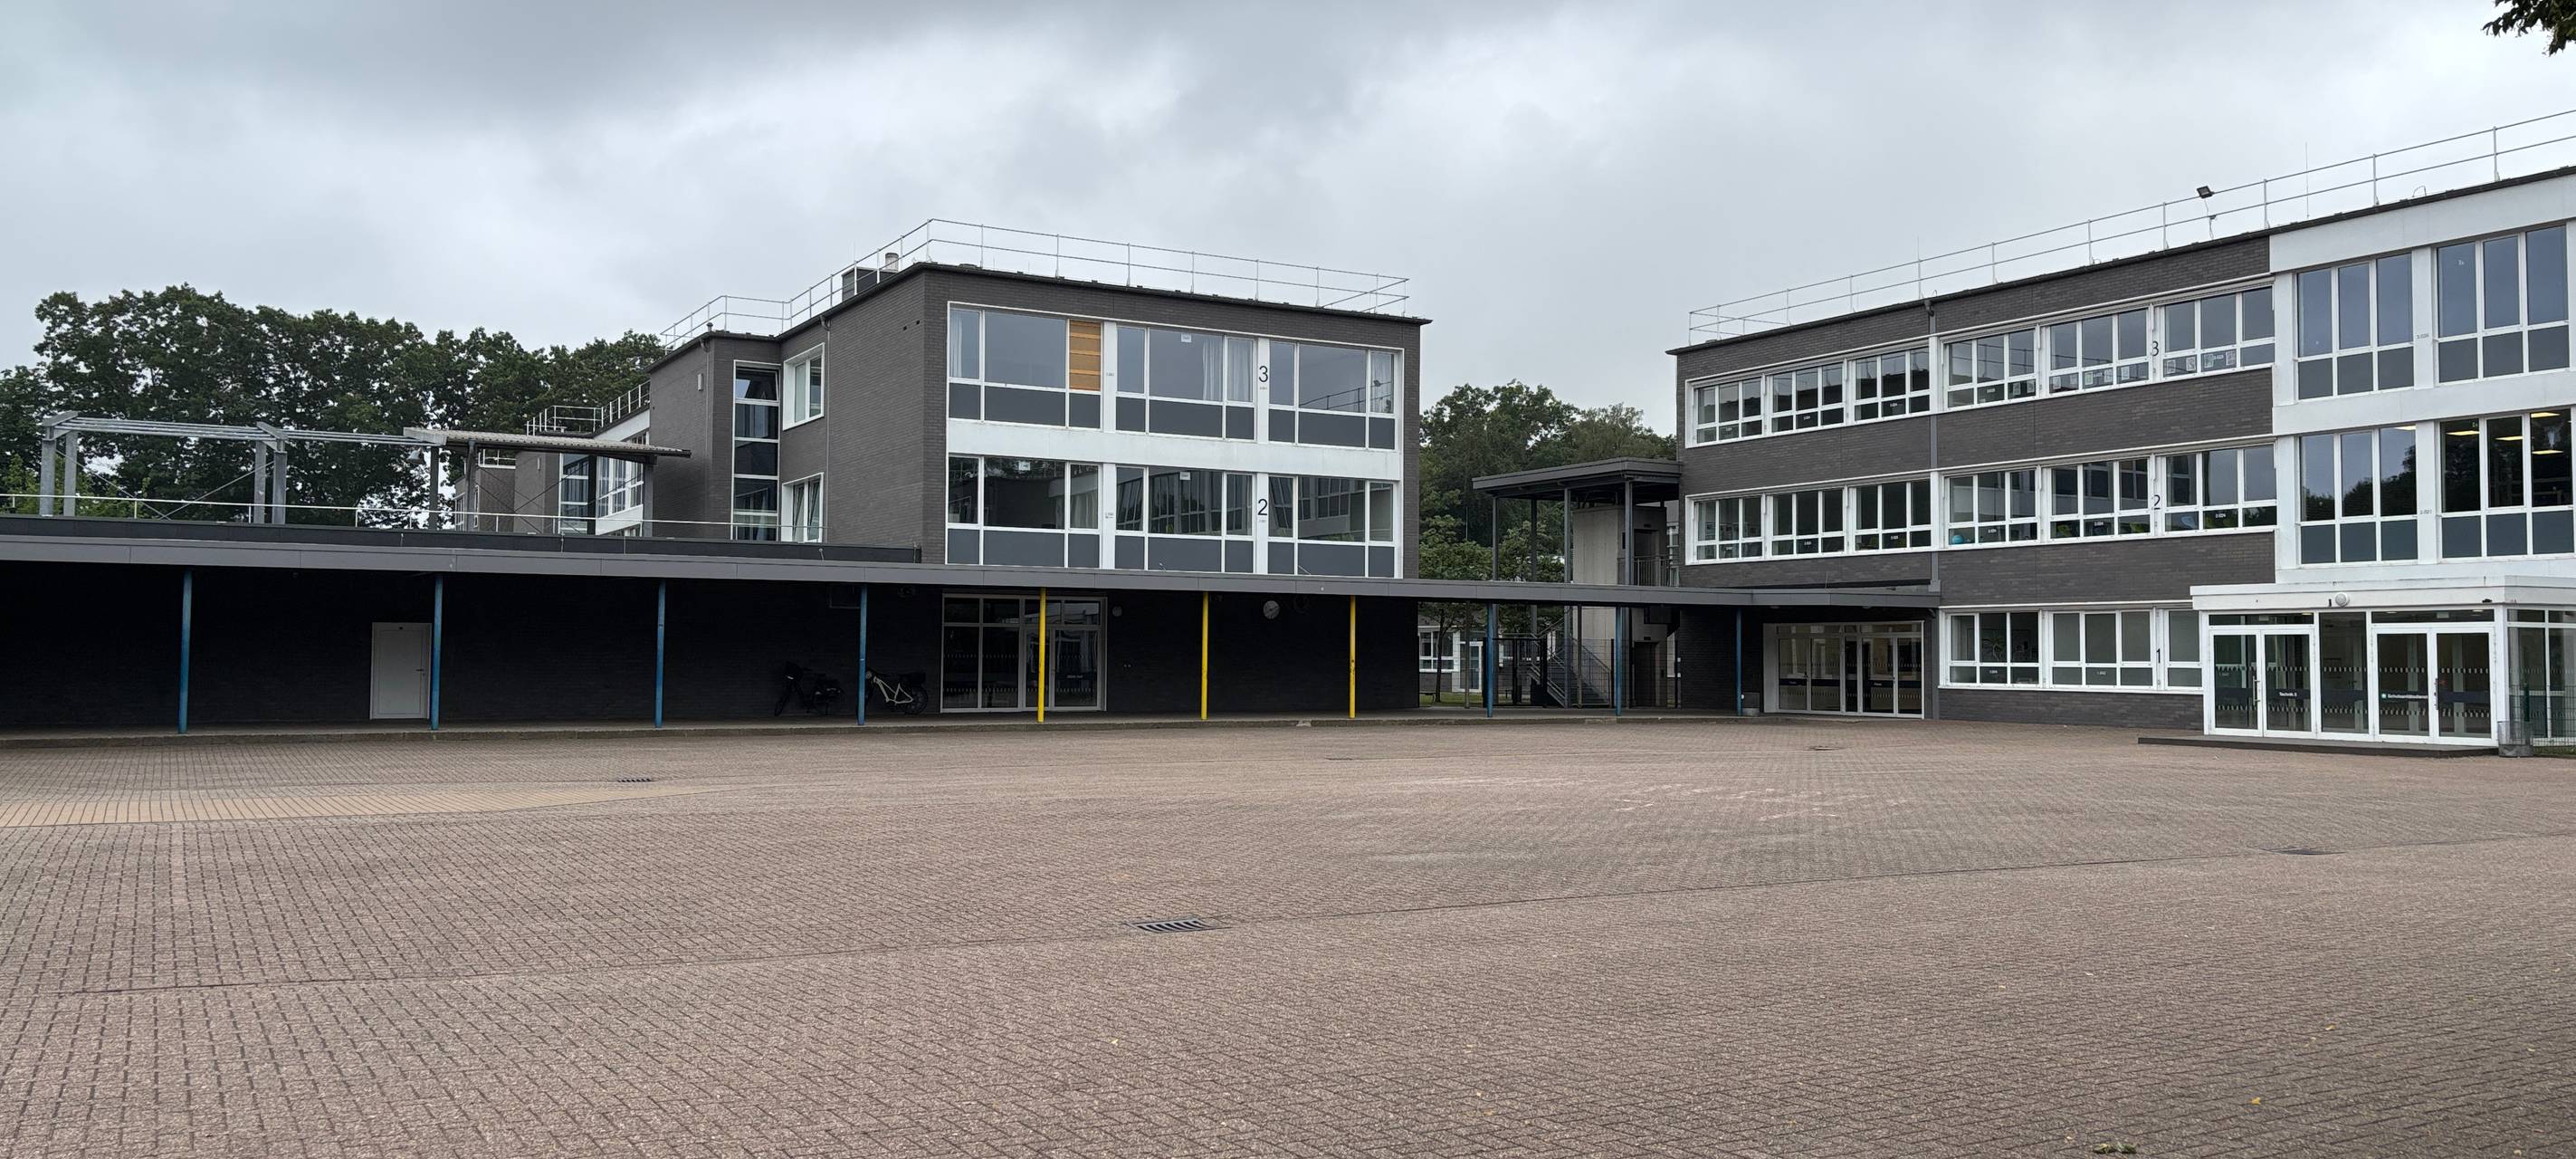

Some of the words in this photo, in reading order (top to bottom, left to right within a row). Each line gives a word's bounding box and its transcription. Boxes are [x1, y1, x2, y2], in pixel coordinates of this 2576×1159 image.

[2151, 341, 2160, 357] 3
[1259, 366, 1269, 383] 3
[1257, 499, 1268, 516] 2
[2151, 495, 2161, 510] 2
[2156, 648, 2161, 664] 1
